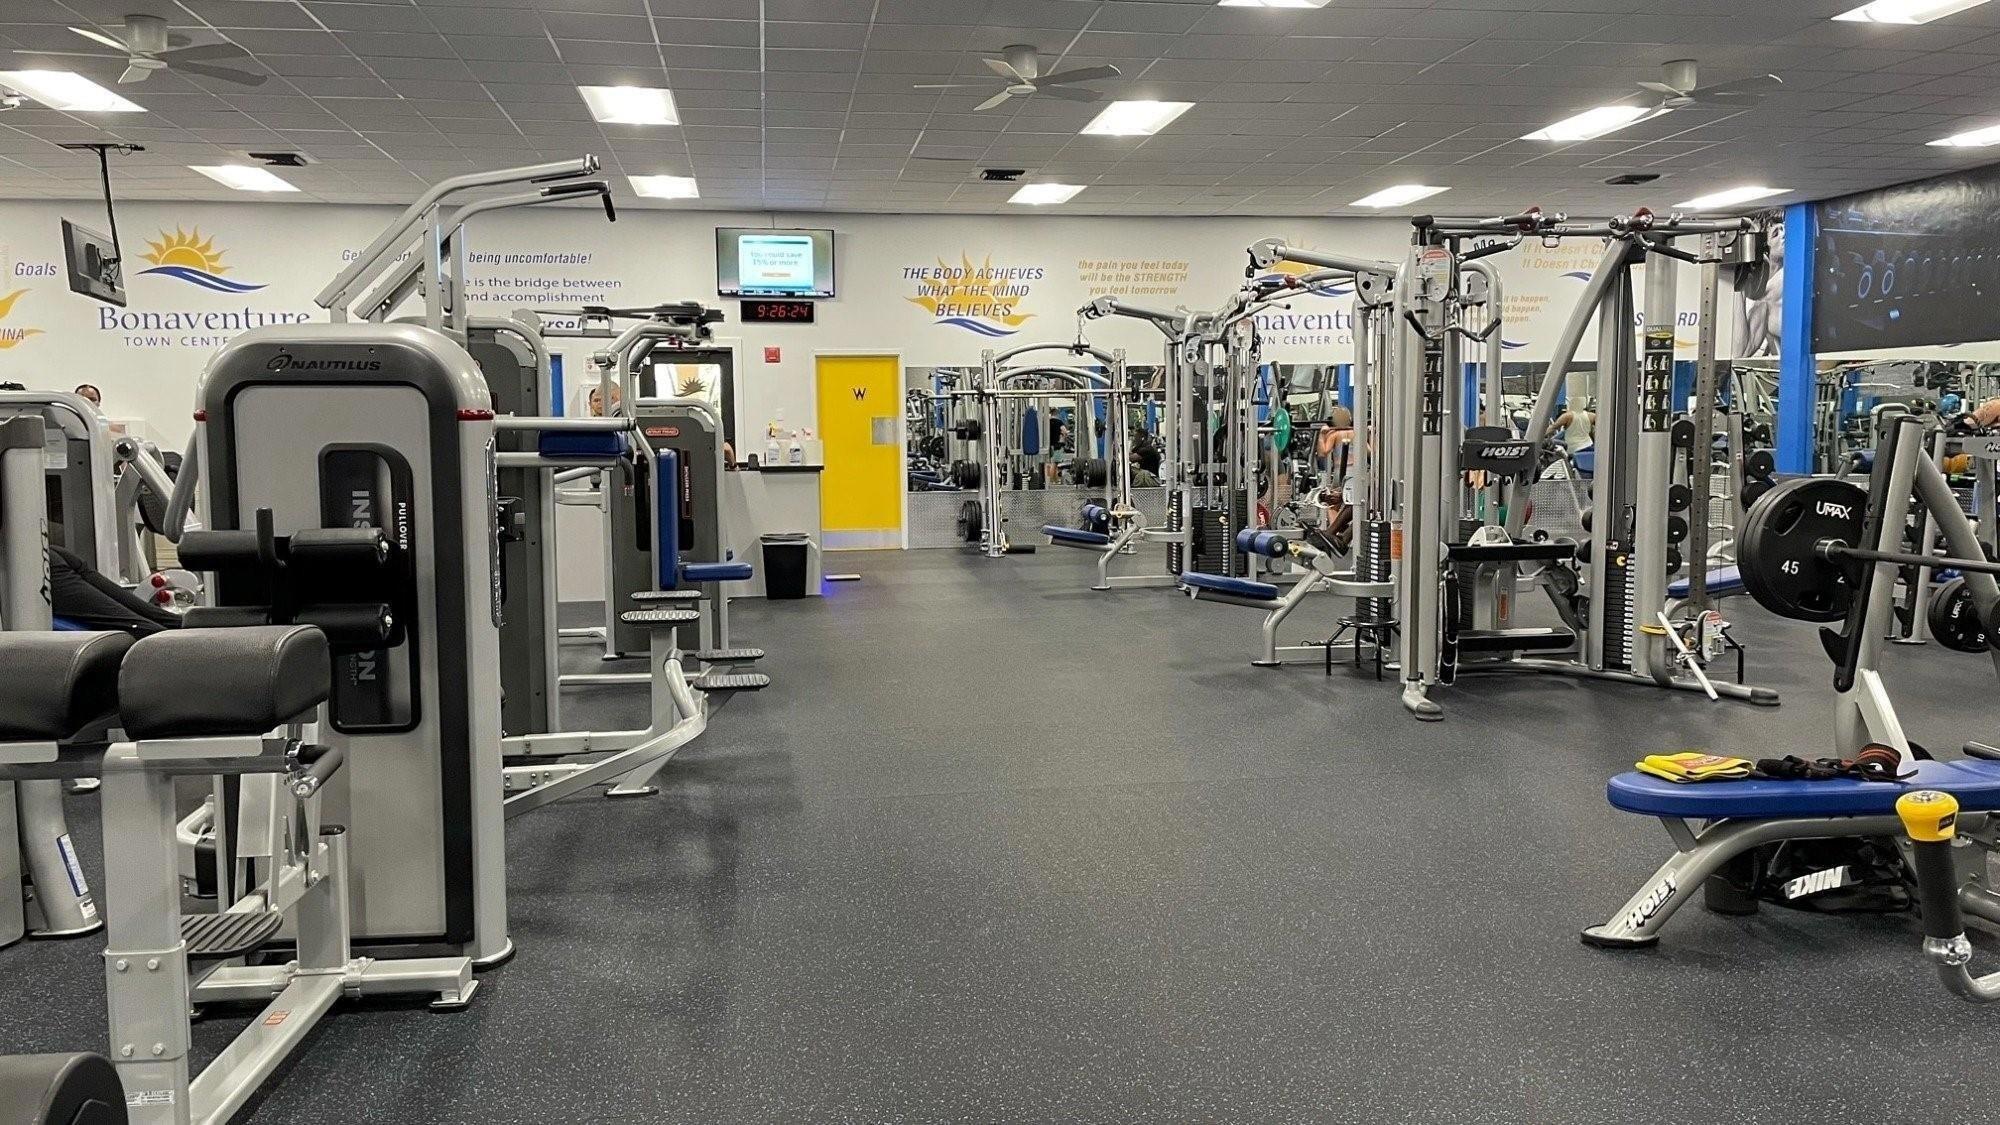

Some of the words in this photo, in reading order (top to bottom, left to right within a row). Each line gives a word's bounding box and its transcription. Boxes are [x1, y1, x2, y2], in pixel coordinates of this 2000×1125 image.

[469, 252, 500, 265] being
[505, 253, 592, 264] uncomfortable!
[15, 262, 57, 276] Goals
[1078, 260, 1093, 269] the
[1095, 261, 1117, 270] pain
[1120, 262, 1138, 271] you
[1140, 260, 1160, 269] feel
[1162, 261, 1189, 271] today
[903, 267, 929, 279] THE
[933, 268, 972, 279] BODY
[976, 268, 1044, 279] ACHIEVES
[1080, 273, 1098, 281] will
[1101, 273, 1113, 281] be
[1116, 273, 1131, 281] the
[1134, 273, 1187, 282] STRENGTH
[475, 278, 484, 287] is
[489, 278, 510, 287] the
[515, 278, 559, 290] bridge
[564, 279, 621, 288] between
[1090, 286, 1106, 295] you
[1109, 285, 1129, 294] feel
[1132, 286, 1177, 294] tomorrow
[918, 285, 955, 297] WHAT
[959, 285, 988, 297] THE
[992, 285, 1029, 297] MIND
[493, 293, 605, 304] accomplishment
[758, 305, 808, 317] 9:26:24
[935, 303, 1012, 316] BELIEVES
[99, 306, 310, 330] Bonaventure
[0, 328, 24, 340] INA
[124, 336, 171, 346] TOWN
[180, 336, 229, 346] CENTE
[1284, 336, 1330, 345] CENTER
[1338, 336, 1353, 344] CL
[290, 360, 381, 371] NAUTILUS
[853, 387, 867, 400] W
[1481, 446, 1530, 459] HOIST
[1816, 500, 1852, 520] UMAX
[398, 502, 408, 550] PULLOVER
[1781, 560, 1800, 575] 45
[1977, 633, 1985, 643] 10
[1624, 870, 1677, 932] HOIST
